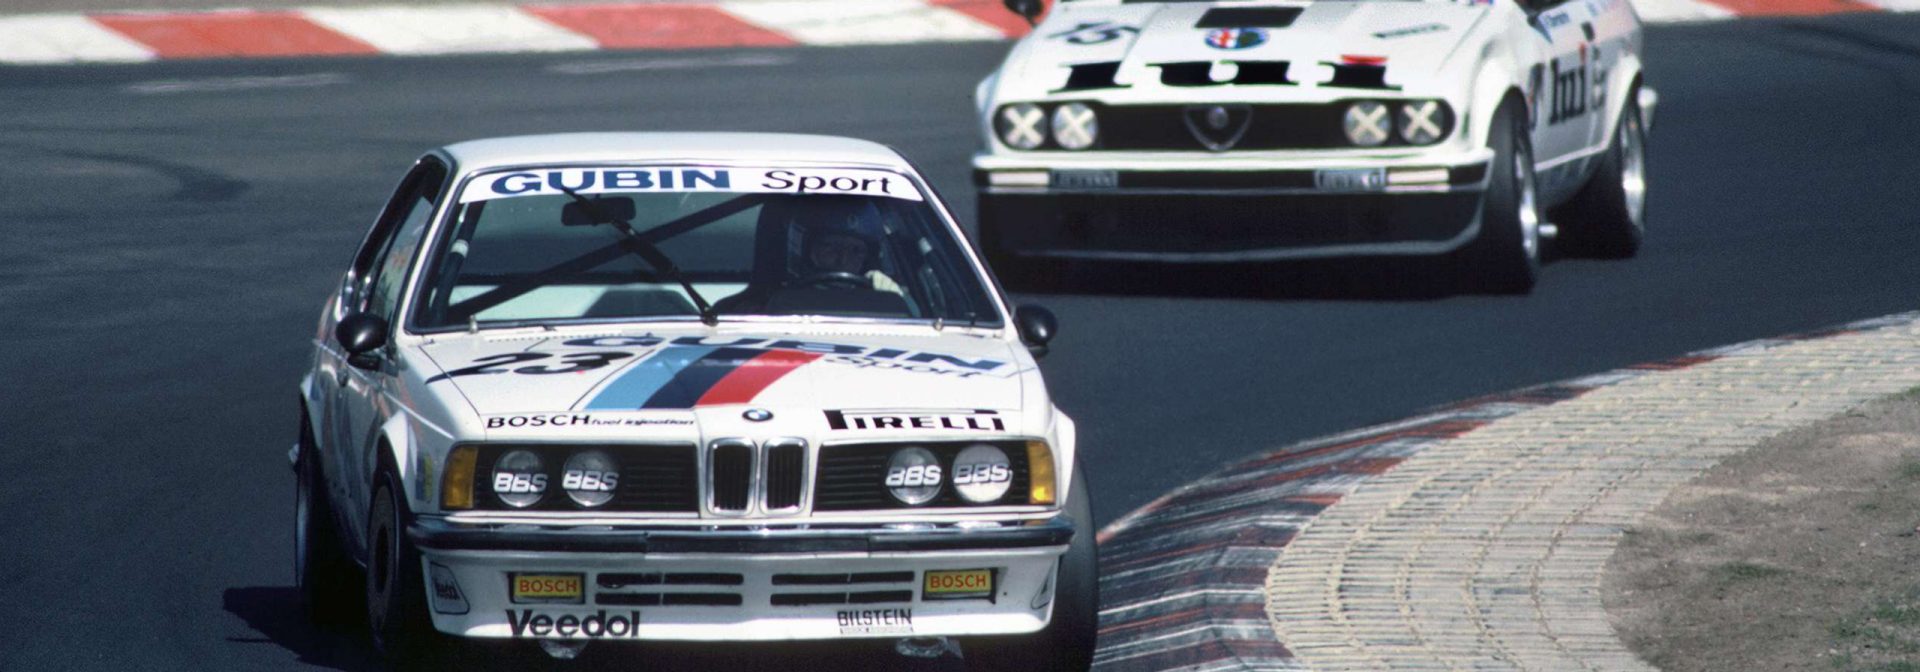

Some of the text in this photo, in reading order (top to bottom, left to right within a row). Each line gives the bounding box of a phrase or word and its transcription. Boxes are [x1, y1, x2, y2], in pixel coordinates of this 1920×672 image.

[1048, 54, 1403, 94] lui
[490, 169, 891, 196] GUBIN Sport
[562, 335, 1006, 371] GUBIN
[425, 351, 634, 384] 23
[486, 414, 590, 429] BOSCH
[823, 408, 1005, 431] PIRELLI
[493, 472, 548, 492] BBS
[562, 470, 619, 490] BBS
[885, 464, 942, 487] BBS
[953, 463, 1010, 484] BBS
[519, 578, 578, 593] BOSCH
[929, 574, 986, 589] BOSCH
[505, 608, 641, 638] Veedol
[837, 608, 912, 628] BILSTEIN
